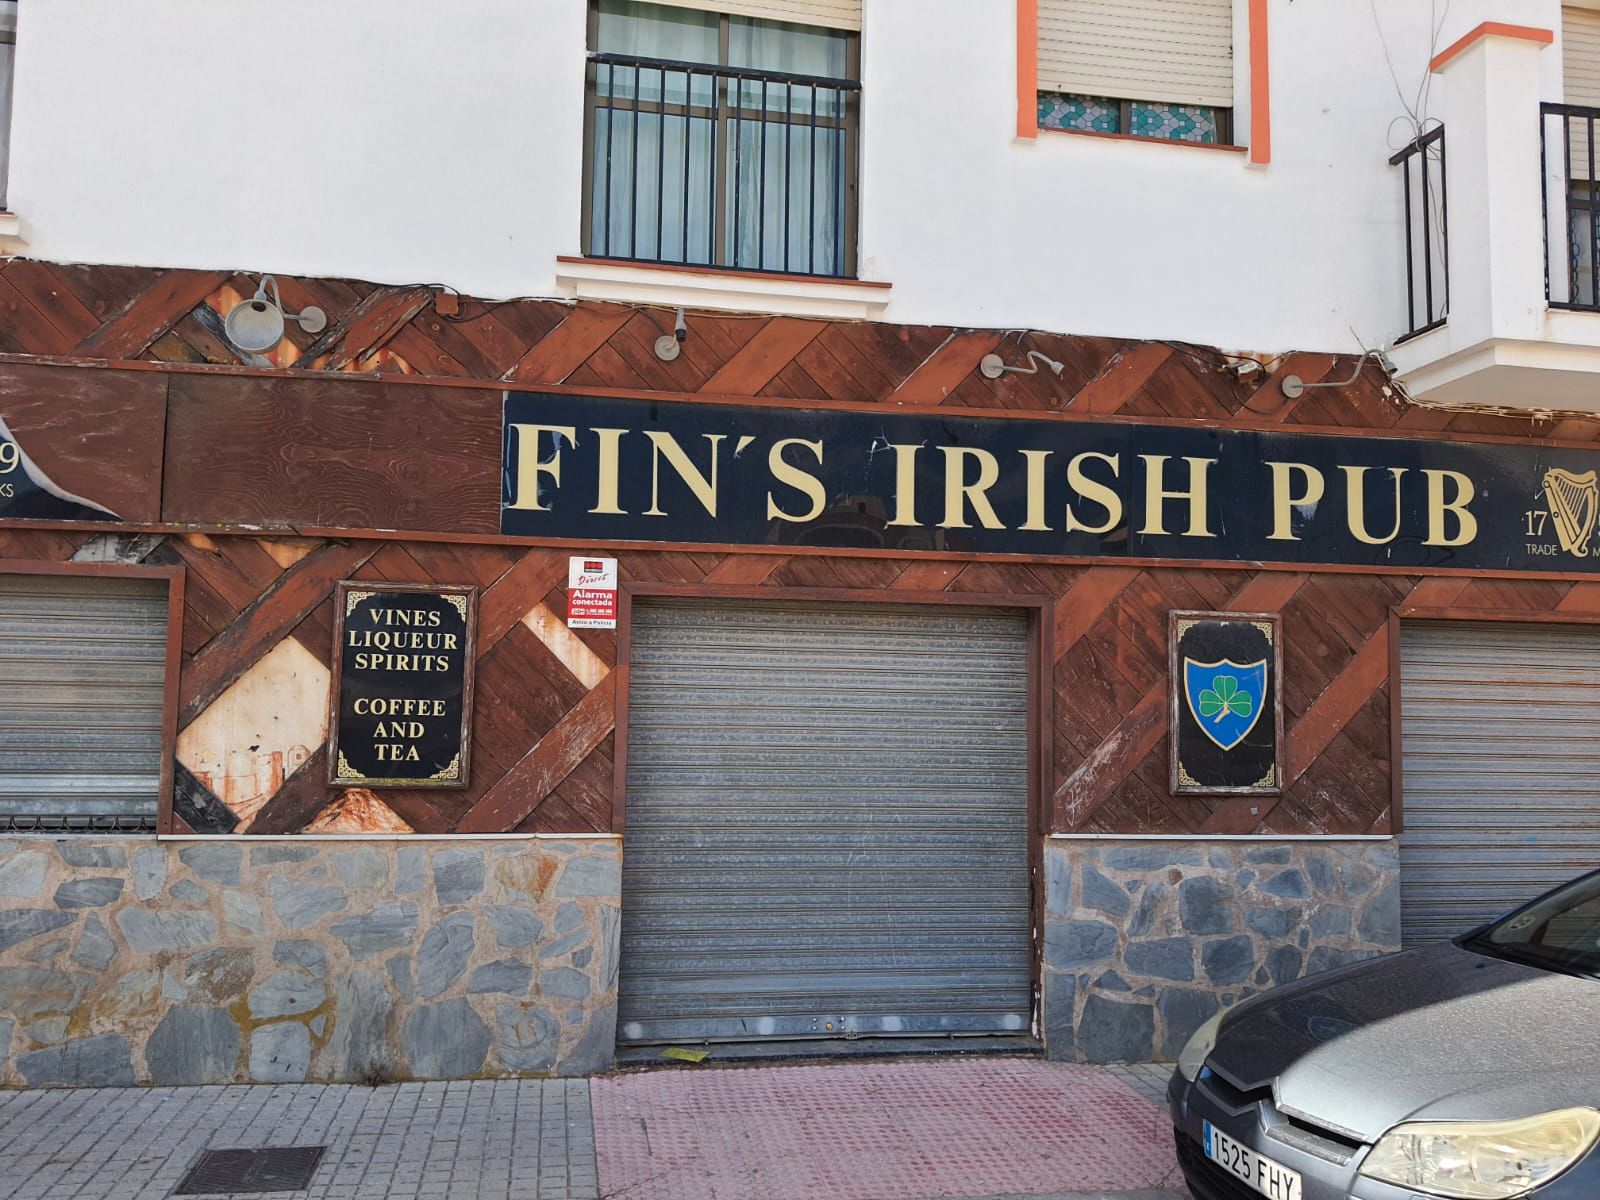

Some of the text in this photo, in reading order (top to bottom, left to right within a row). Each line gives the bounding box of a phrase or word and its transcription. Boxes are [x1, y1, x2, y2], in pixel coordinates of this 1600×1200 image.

[886, 444, 1217, 537] IRISH
[1264, 461, 1479, 547] PUB
[1525, 543, 1558, 556] TRADE
[573, 589, 612, 599] Alarma
[369, 608, 441, 627] VINES
[348, 630, 457, 651] LIQUEUR
[355, 653, 449, 672] SPIRITS
[353, 698, 446, 716] COFFEE
[373, 721, 425, 739] AND
[374, 744, 420, 761] TEA
[1215, 1132, 1251, 1179] 1525
[1257, 1159, 1293, 1200] FHY
